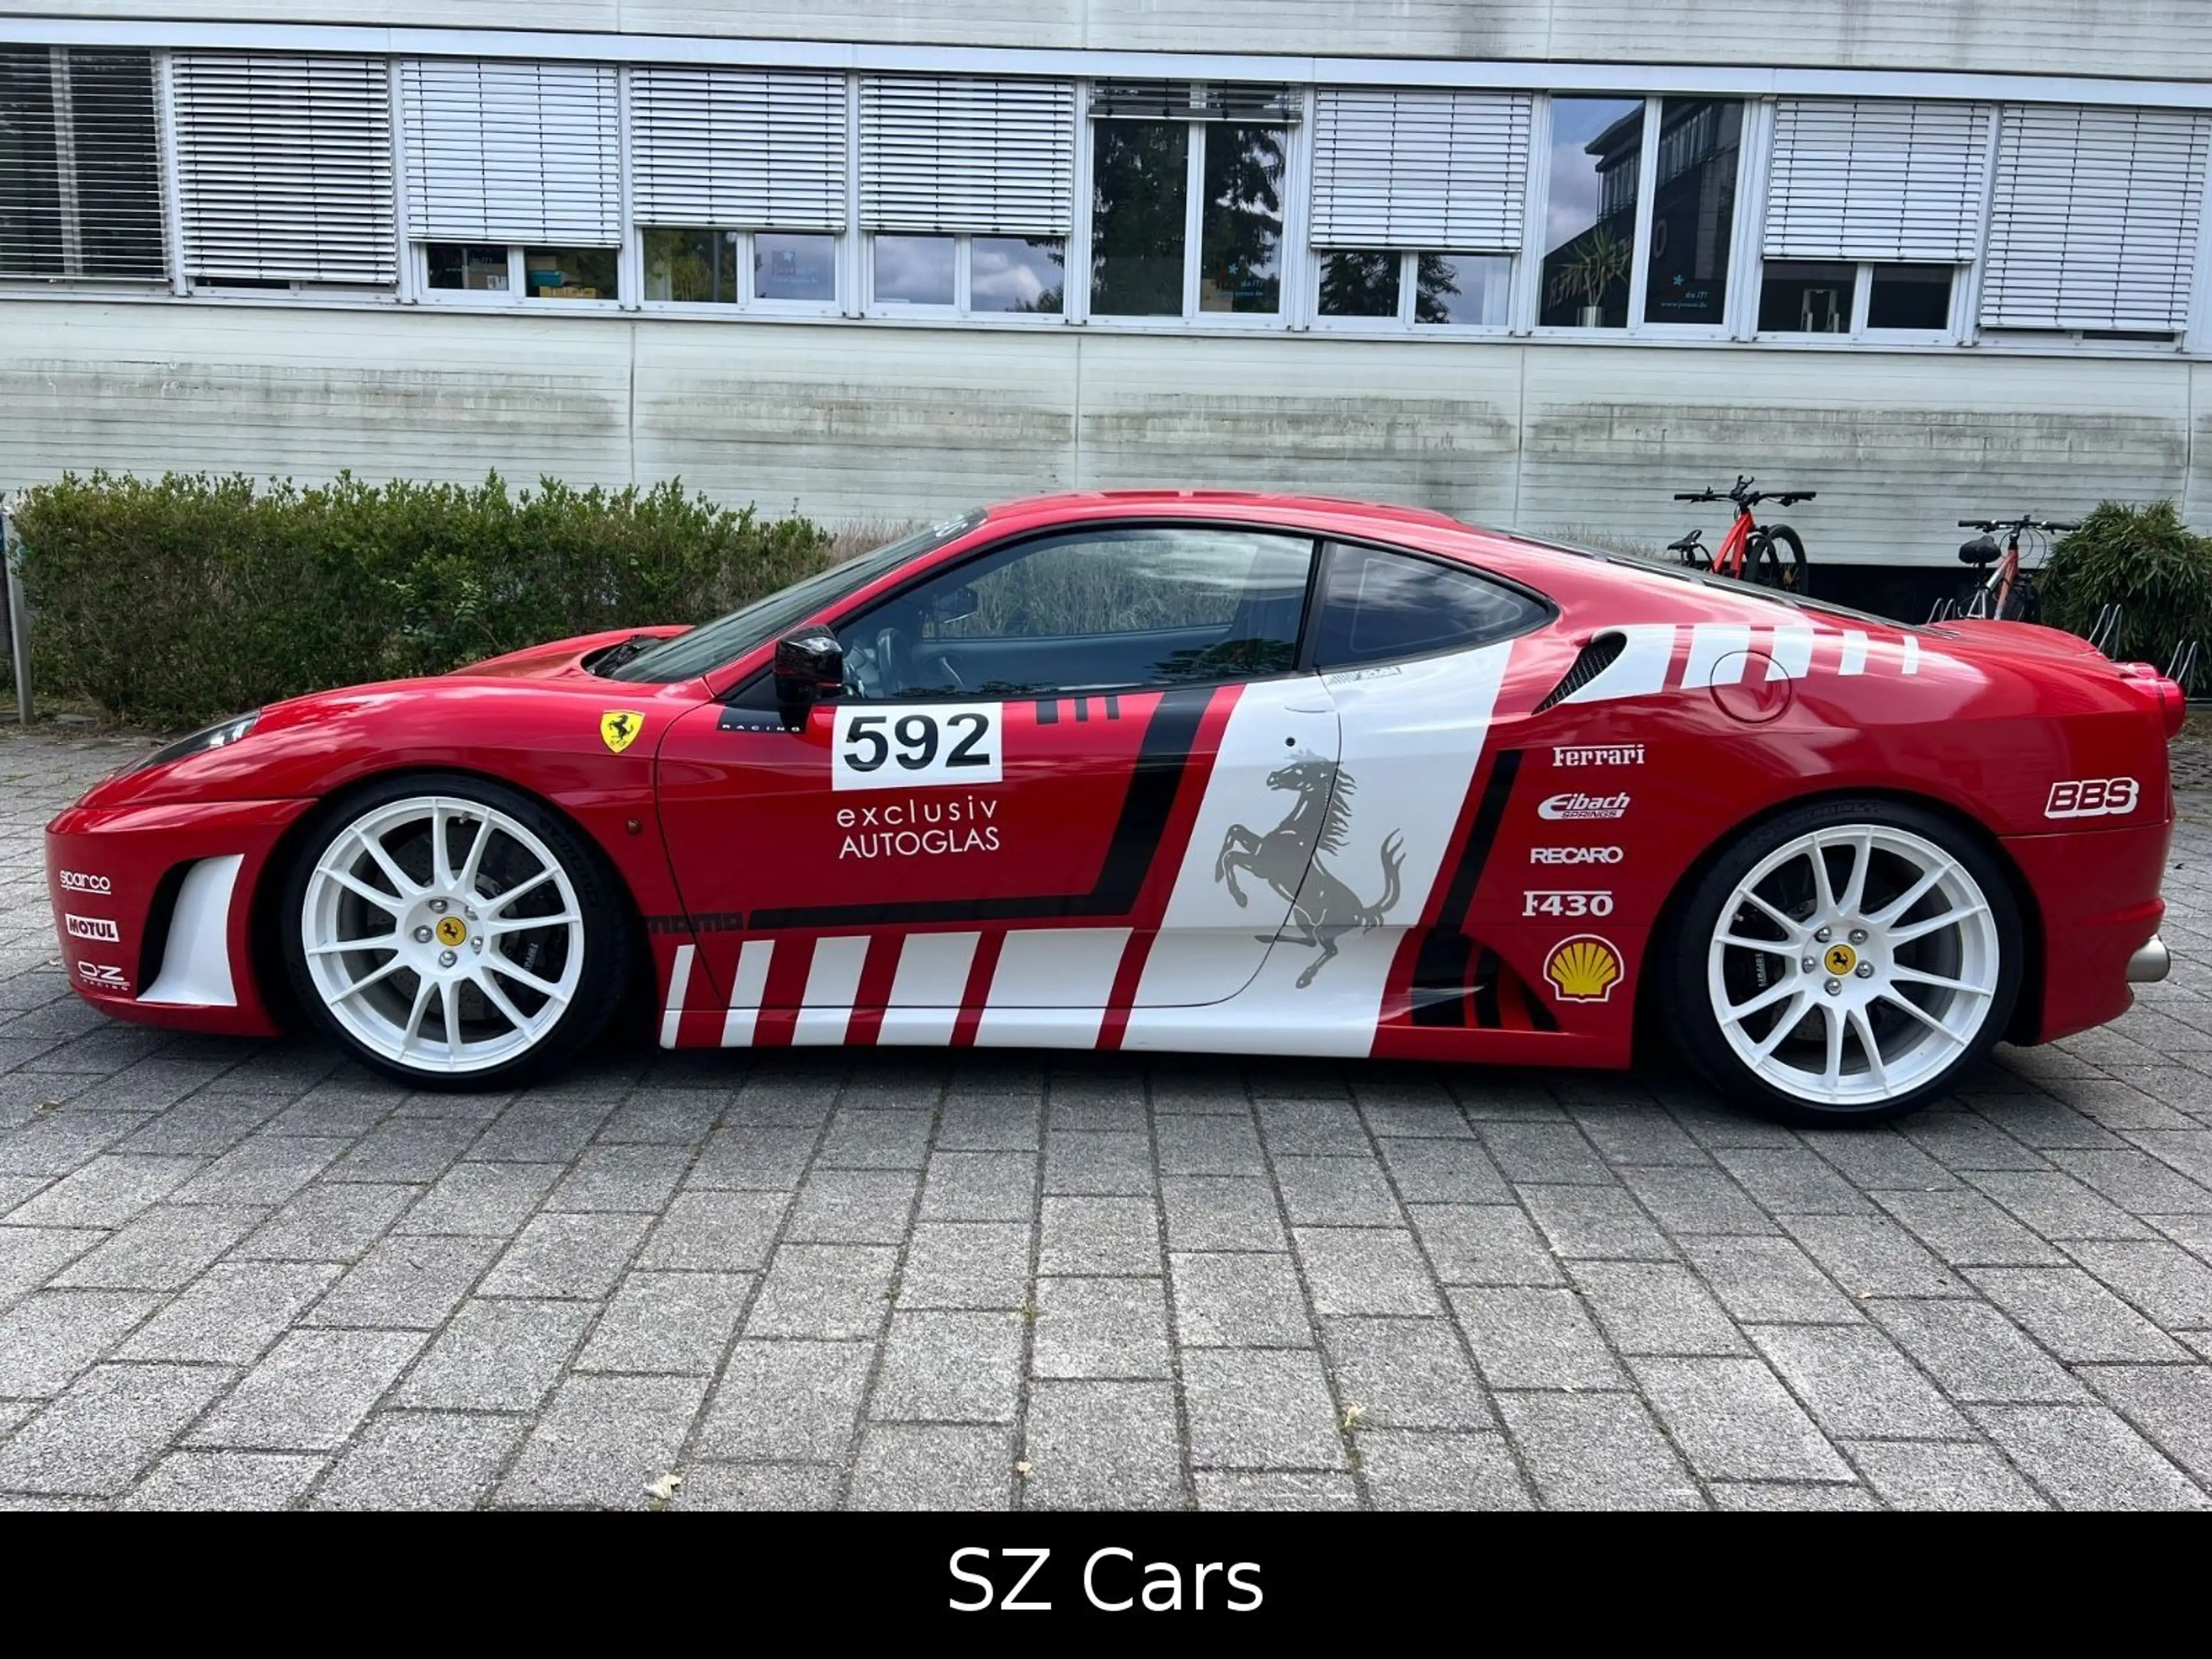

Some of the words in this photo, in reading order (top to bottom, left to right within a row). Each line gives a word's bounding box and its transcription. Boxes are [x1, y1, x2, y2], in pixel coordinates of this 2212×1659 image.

[843, 713, 990, 772] 592
[1552, 744, 1645, 766] Ferrari
[1537, 792, 1631, 820] Eibach
[2044, 777, 2139, 819] BBS
[836, 795, 997, 828] exclusiv
[839, 826, 1000, 859] AUTOGLAS
[1531, 846, 1623, 864] RECARO
[59, 870, 111, 894] sparco
[1522, 891, 1613, 916] F430
[68, 918, 115, 938] MOTUL
